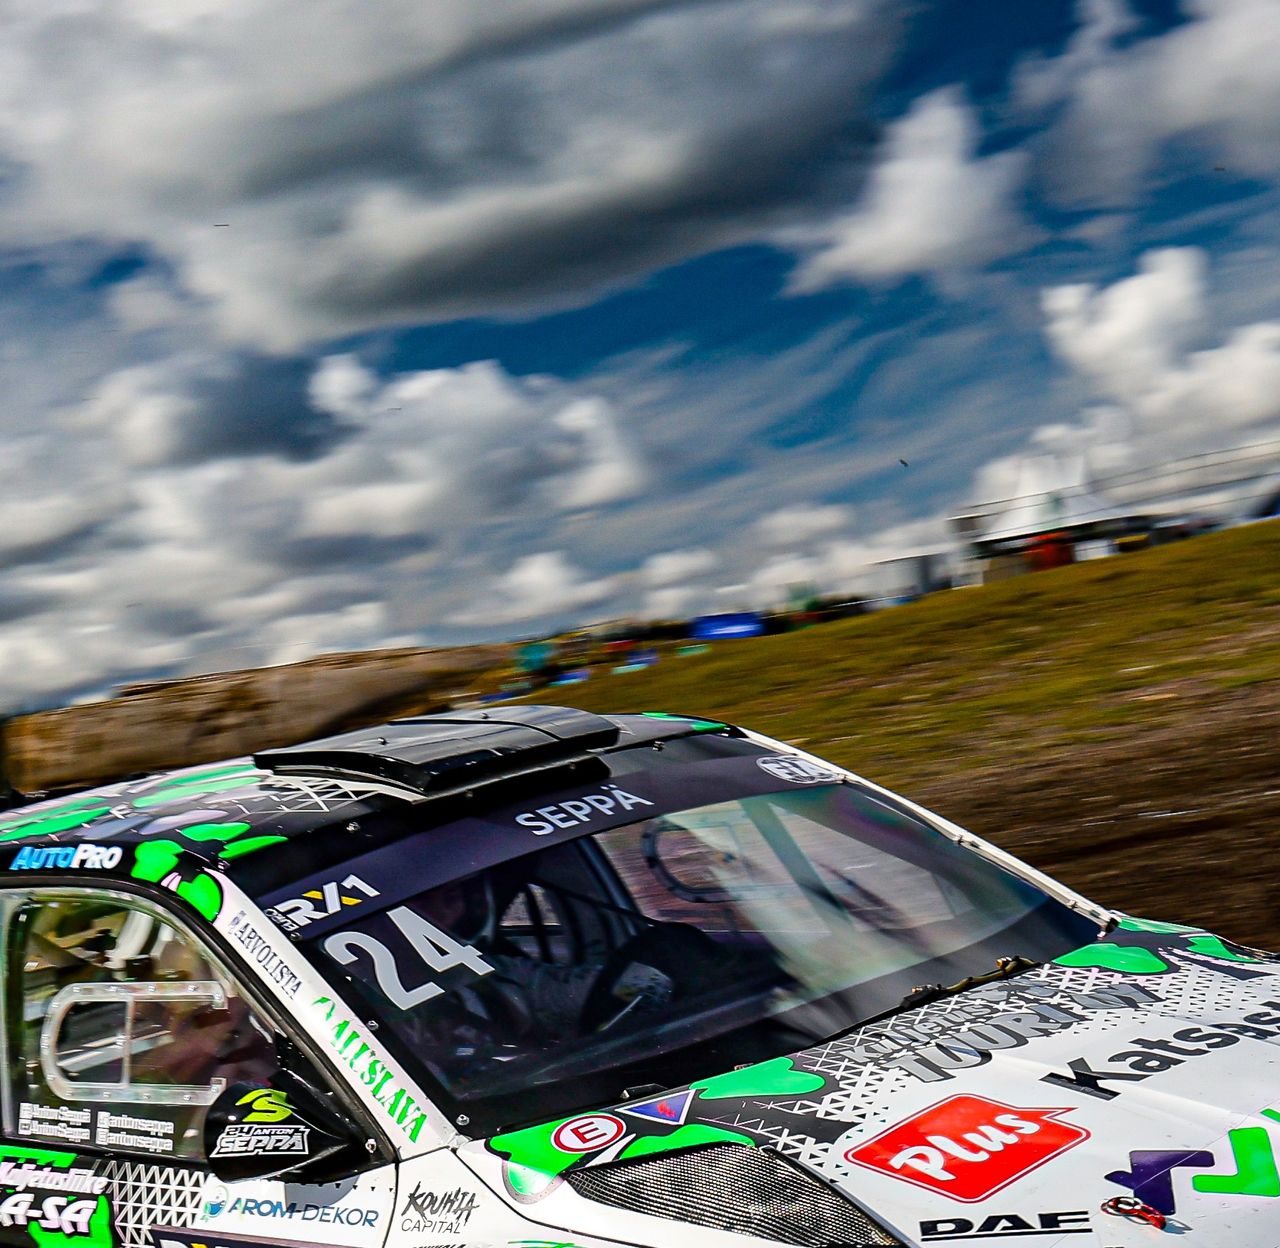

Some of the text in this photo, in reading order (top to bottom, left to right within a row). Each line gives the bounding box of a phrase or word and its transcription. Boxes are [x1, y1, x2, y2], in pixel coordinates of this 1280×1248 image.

[515, 784, 654, 837] SEPPÄ
[274, 874, 381, 926] RX1
[234, 922, 302, 1000] ARVOLISTA
[323, 905, 494, 1011] 24
[881, 1003, 1084, 1083] TUURI
[253, 1128, 294, 1136] ANTON
[401, 1218, 461, 1234] CAPITAL
[920, 1210, 1092, 1236] DAF
